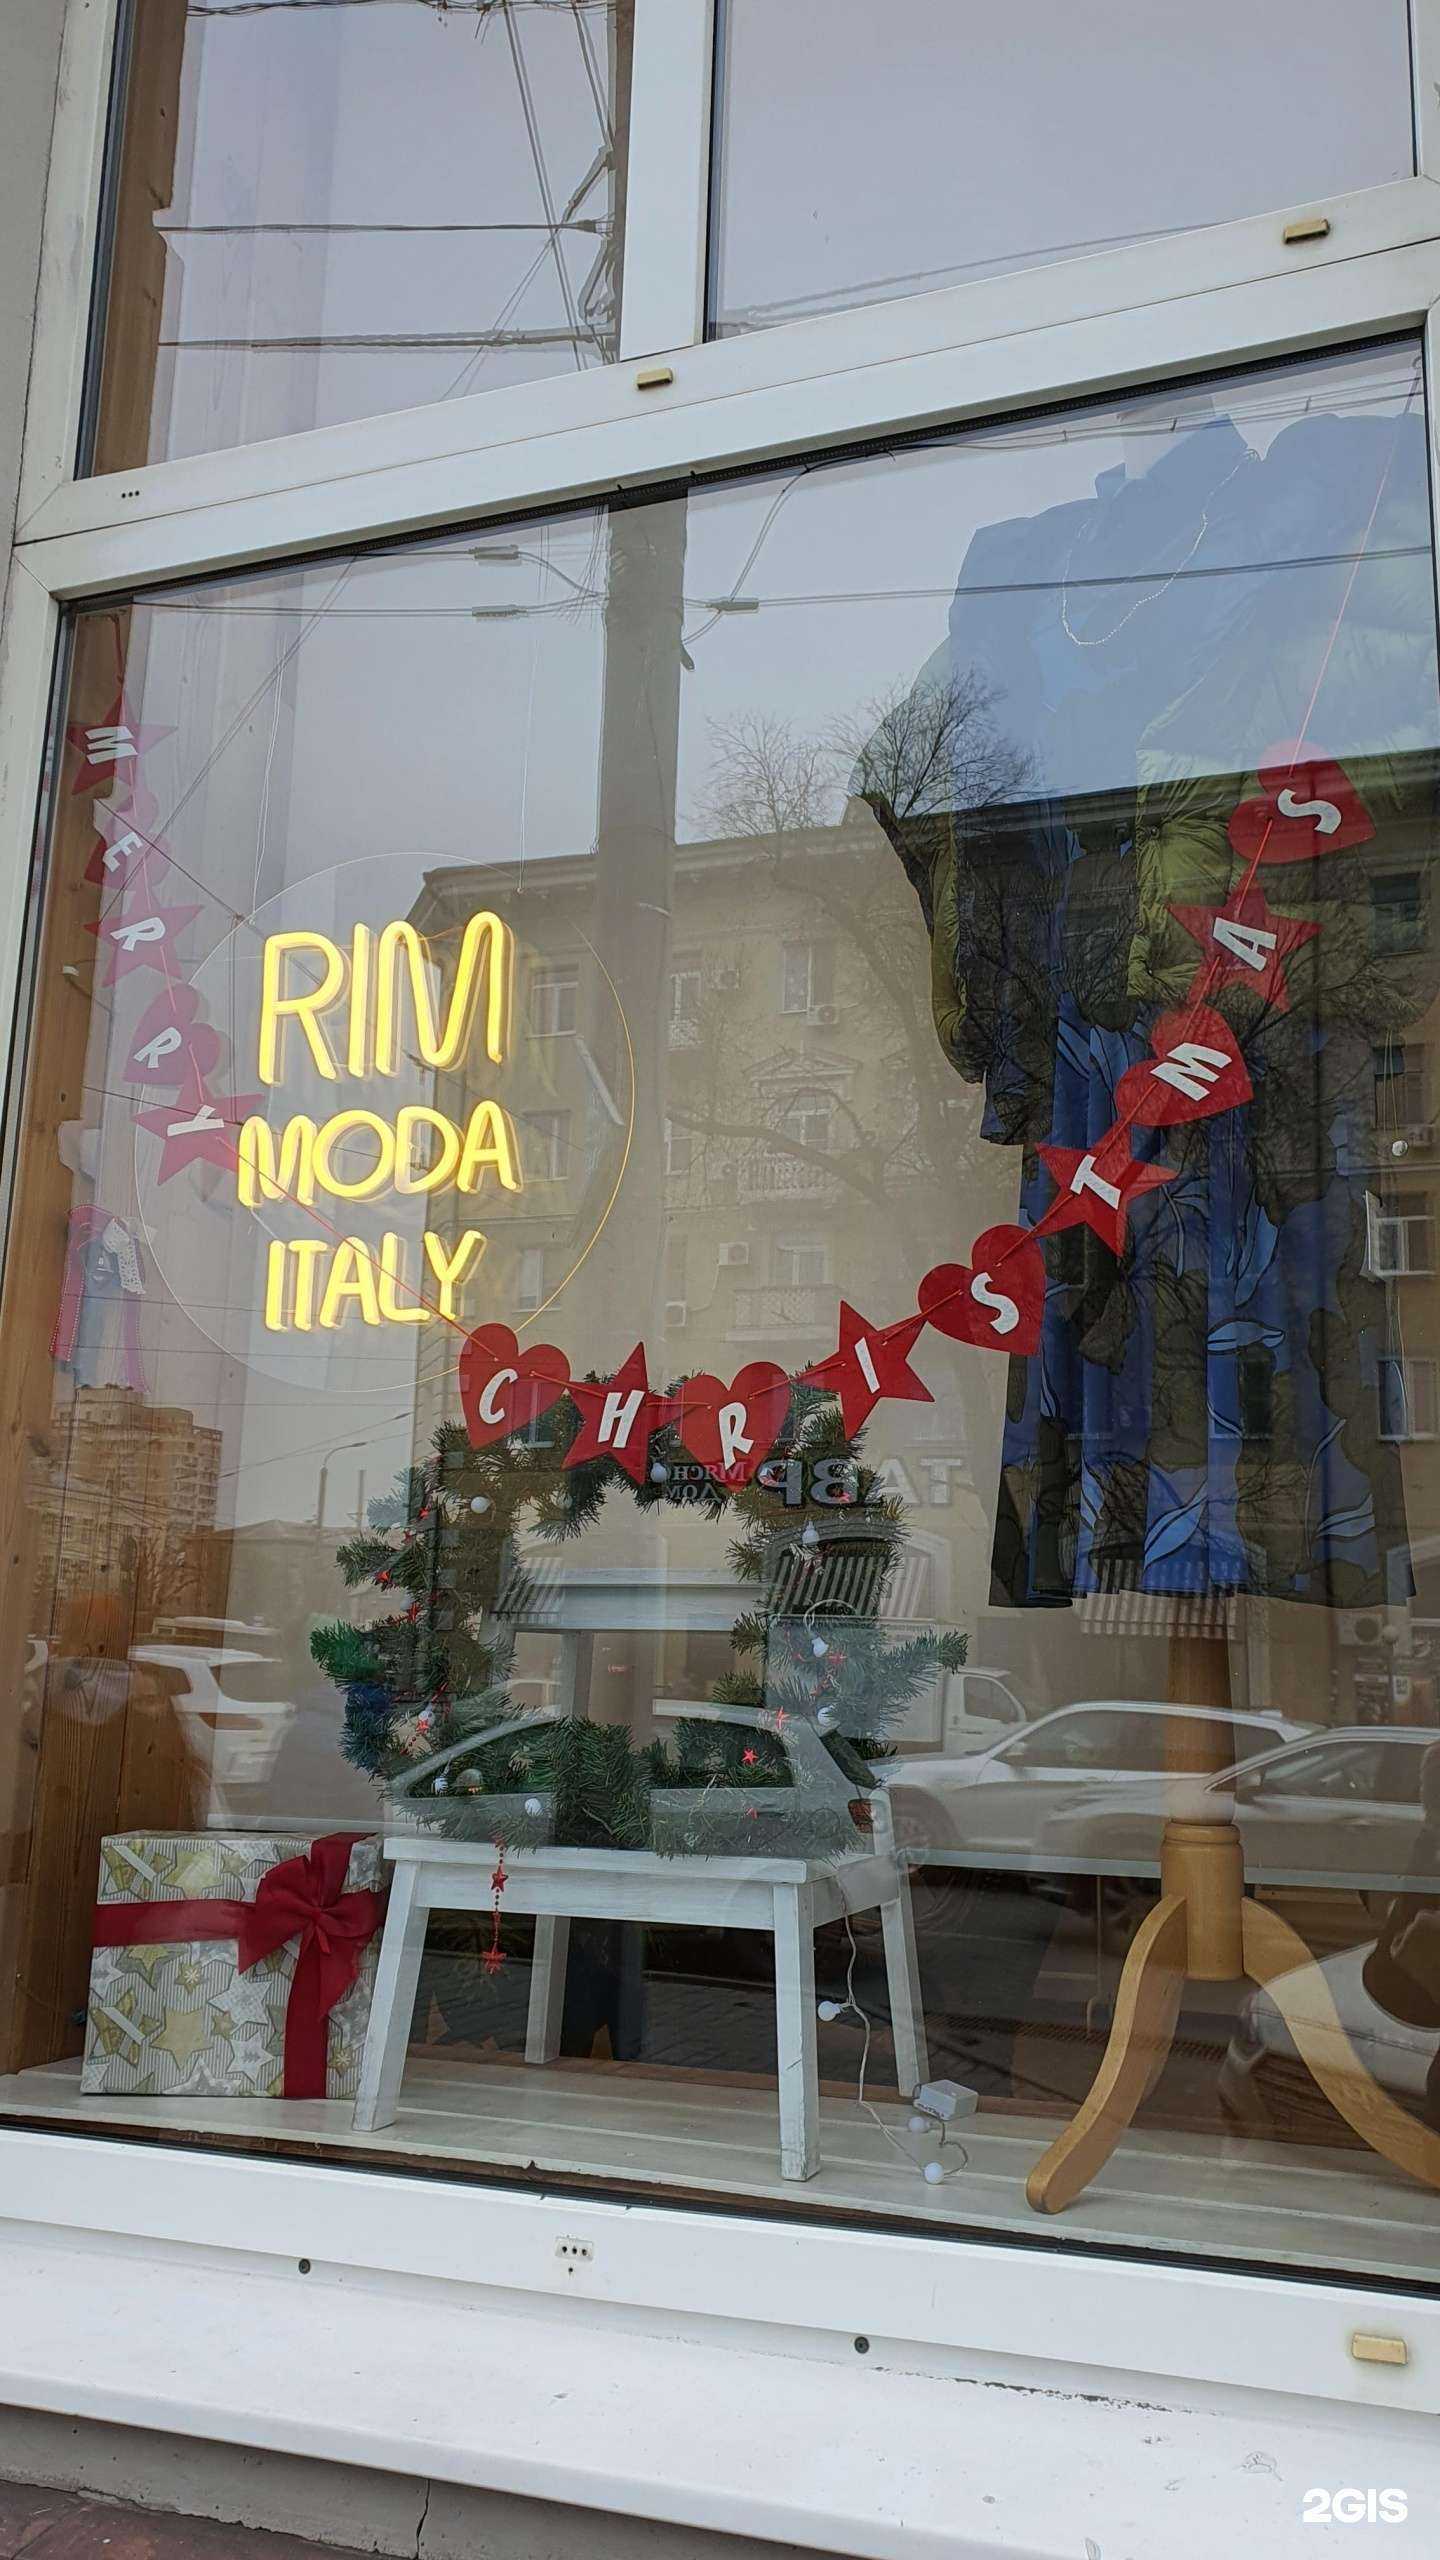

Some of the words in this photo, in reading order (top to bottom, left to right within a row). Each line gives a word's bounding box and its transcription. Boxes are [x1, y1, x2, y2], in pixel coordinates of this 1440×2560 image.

[259, 911, 510, 1085] RIM
[85, 725, 225, 1137] MERRY
[478, 788, 1342, 1470] CHRISTMAS
[238, 1101, 521, 1206] MODA
[265, 1230, 486, 1331] ITALY
